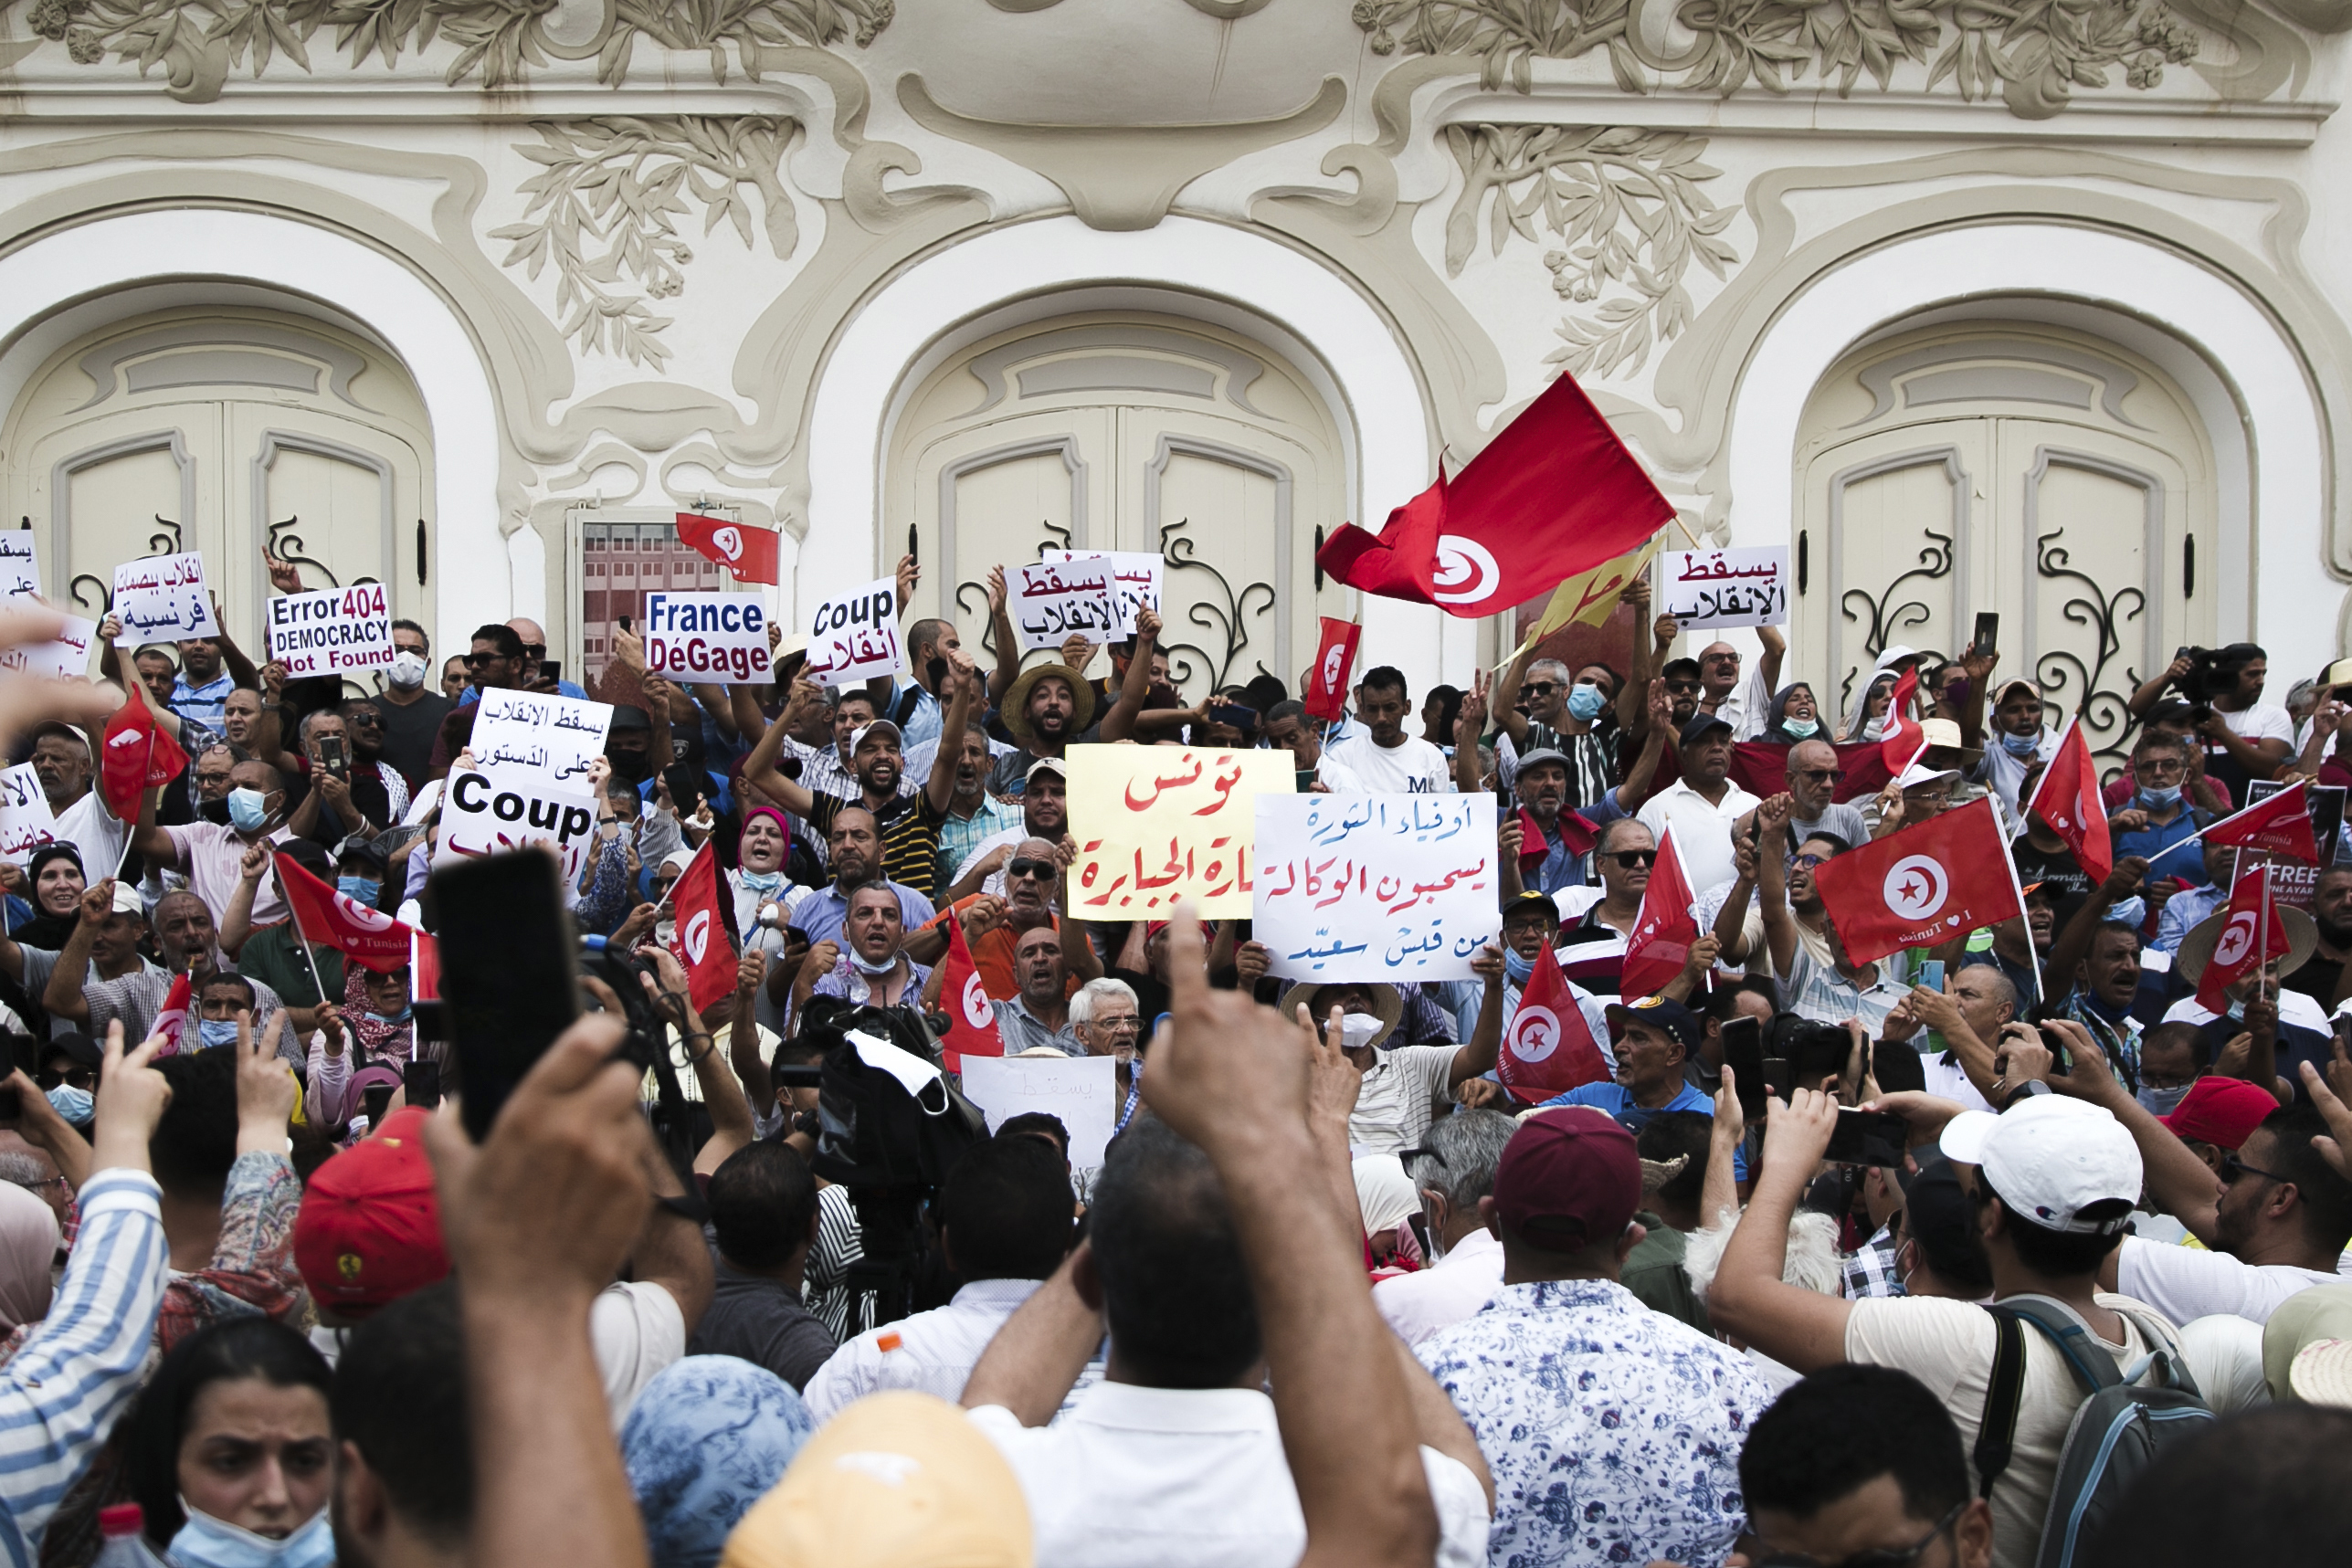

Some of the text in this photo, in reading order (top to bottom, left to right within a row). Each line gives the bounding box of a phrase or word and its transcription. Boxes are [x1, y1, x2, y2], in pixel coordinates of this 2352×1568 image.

[0, 538, 32, 563] يسق
[1678, 552, 1777, 585] يسقط
[1022, 567, 1107, 599] يسقط
[124, 595, 206, 636] فرنسية
[650, 595, 763, 632] France
[813, 590, 893, 637] Coup
[1022, 598, 1122, 642] الإنقلاب
[1669, 584, 1786, 626] الإنقلاب
[277, 620, 388, 652] DEMOCRACY
[329, 645, 395, 668] Found
[650, 637, 769, 680] DéGage
[485, 700, 604, 741] يسقط الإنقلاب
[554, 753, 592, 780] على
[1124, 752, 1242, 816] تونس
[452, 773, 592, 844] Coup
[1307, 797, 1472, 847] أوفياء الثورة
[1263, 855, 1487, 917] يسحبون الوكالة
[364, 937, 409, 949] Tunisia
[1453, 934, 1490, 958] من
[1011, 1073, 1092, 1100] يسقط
